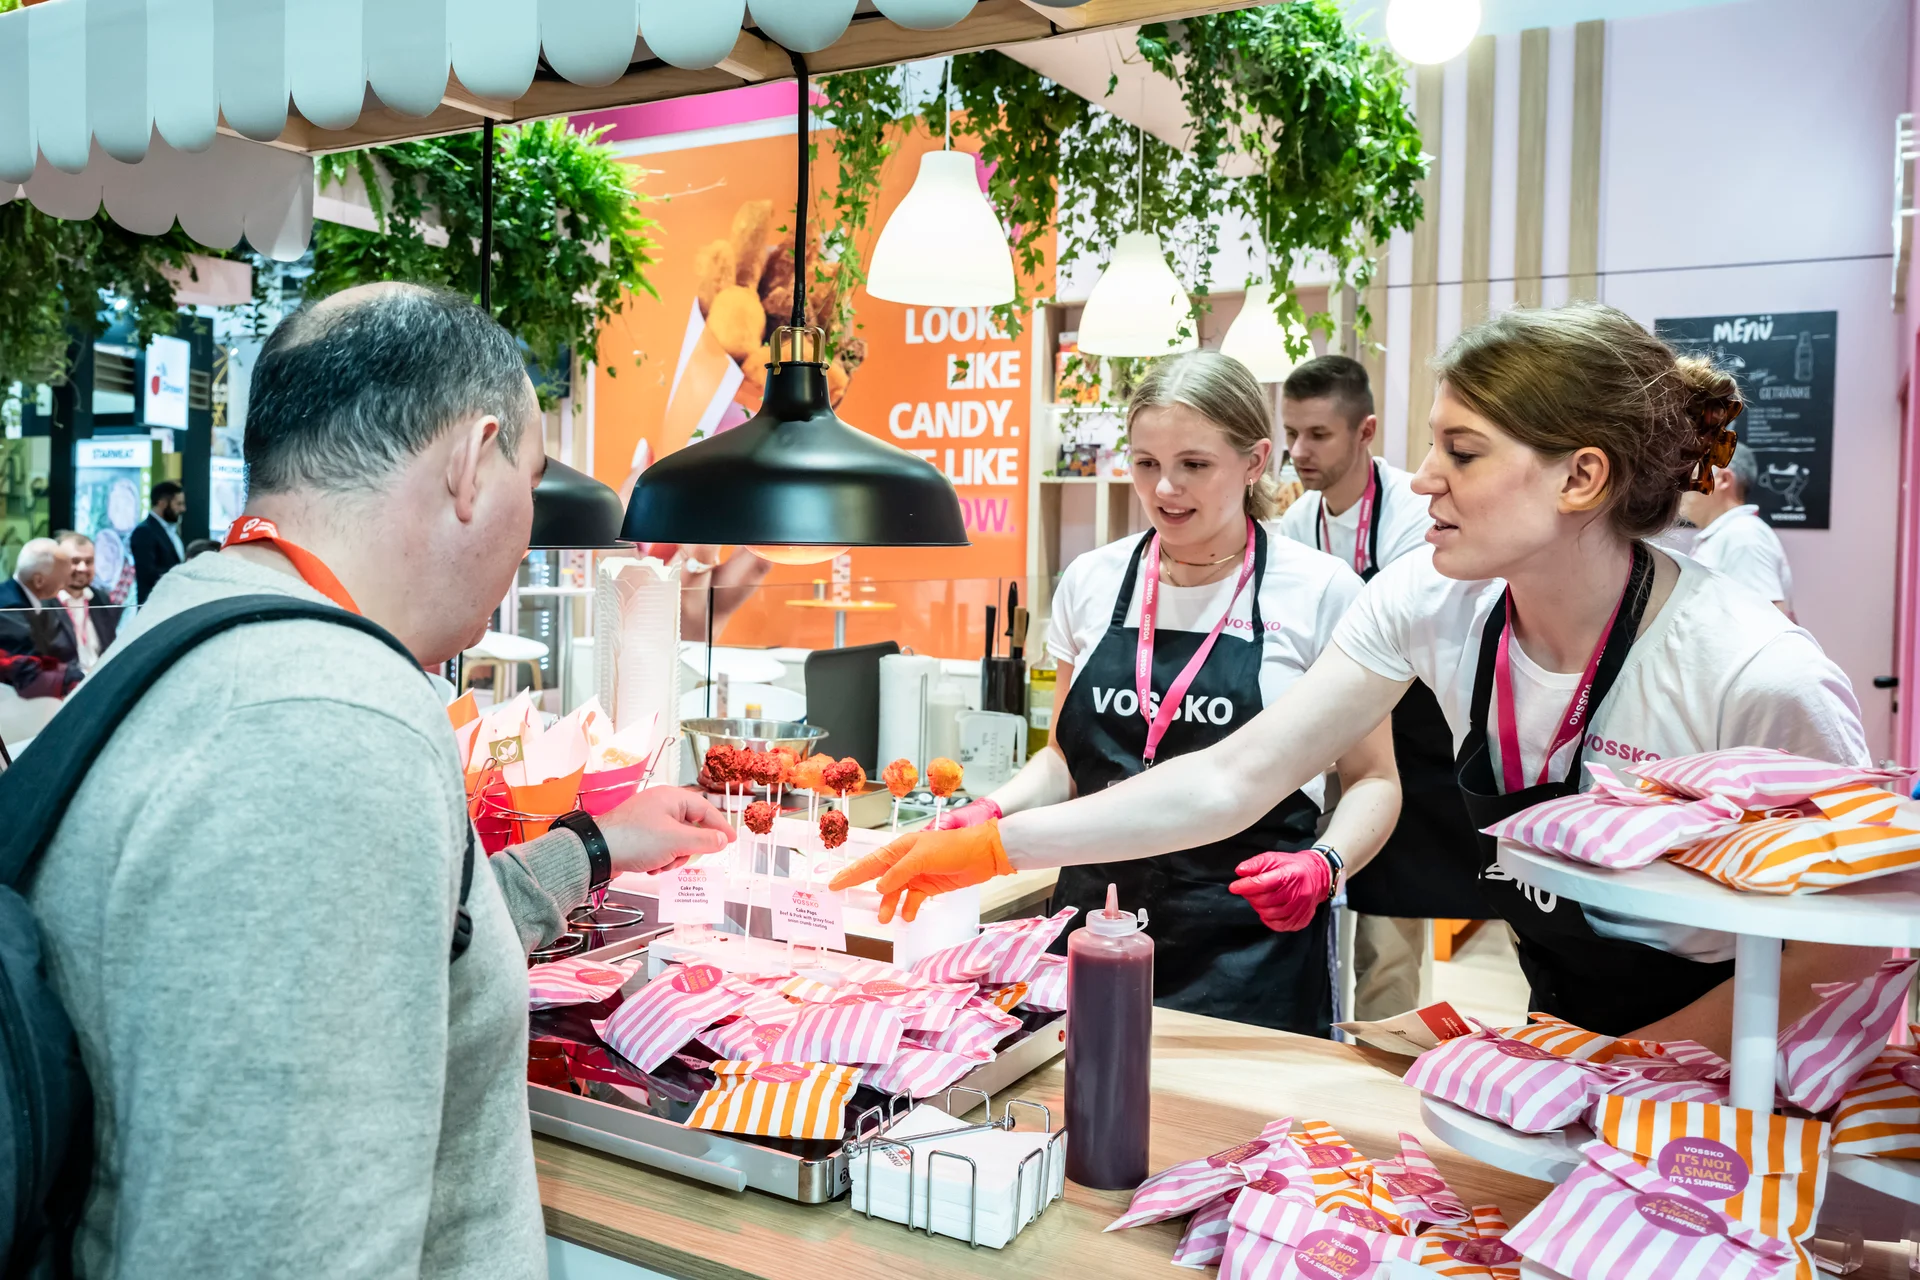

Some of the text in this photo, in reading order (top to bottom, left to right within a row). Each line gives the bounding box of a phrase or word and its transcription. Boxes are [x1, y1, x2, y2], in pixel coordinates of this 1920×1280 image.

[905, 306, 1020, 344] LOOK
[947, 351, 1021, 390] LIKE
[889, 400, 1020, 439] CANDY.
[944, 448, 1018, 485] LIKE
[1145, 578, 1155, 605] VOSSKO
[1142, 613, 1151, 640] VOSSKO
[1225, 618, 1281, 631] VOSKO
[1140, 649, 1148, 677] VOSSKO
[1569, 684, 1592, 725] VOSSKO
[792, 898, 819, 908] VOSSKO
[883, 1149, 904, 1167] OSSKO
[1683, 1145, 1725, 1158] VOSSKO
[1675, 1153, 1733, 1171] IT'S NOT
[1669, 1175, 1684, 1184] IT'S
[1693, 1178, 1737, 1192] SURPRISE.
[1670, 1165, 1736, 1184] A SNACK.
[1641, 1206, 1657, 1215] IT'S
[1331, 1237, 1359, 1255] VOSSKO
[1298, 1253, 1311, 1262] IT'S
[1305, 1247, 1351, 1275] A SNACK.
[1334, 1251, 1359, 1267] NOT
